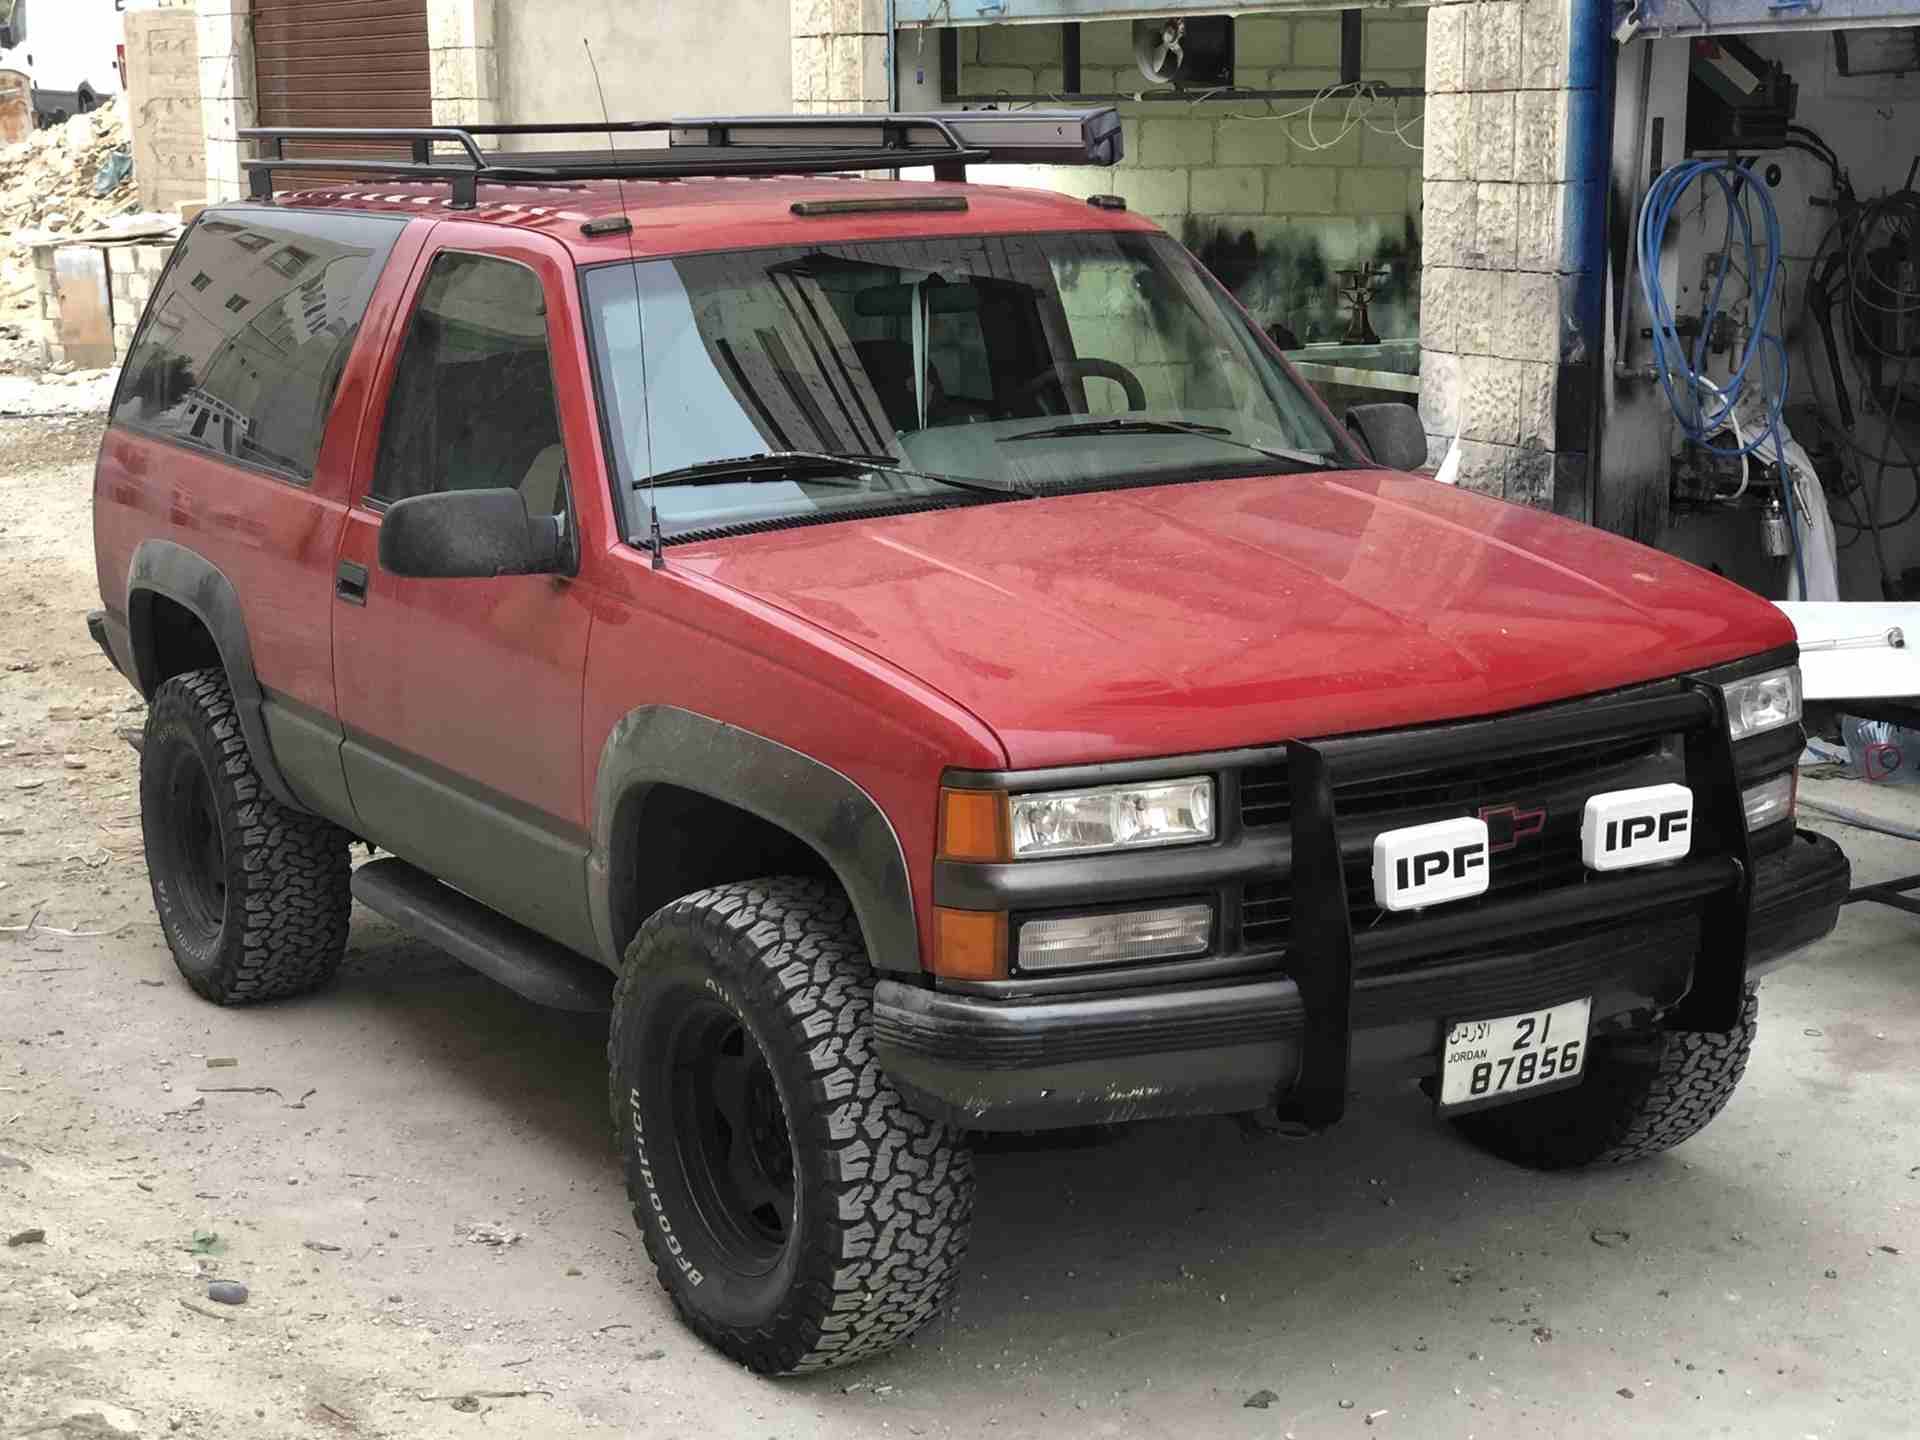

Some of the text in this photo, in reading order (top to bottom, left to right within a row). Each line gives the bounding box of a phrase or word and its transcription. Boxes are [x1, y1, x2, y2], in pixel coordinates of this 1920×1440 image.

[1606, 809, 1688, 852] IPF
[1397, 843, 1484, 890] IPF
[1512, 1013, 1551, 1050] 21
[1448, 1049, 1488, 1064] JORDAN
[1470, 1040, 1580, 1095] 87856
